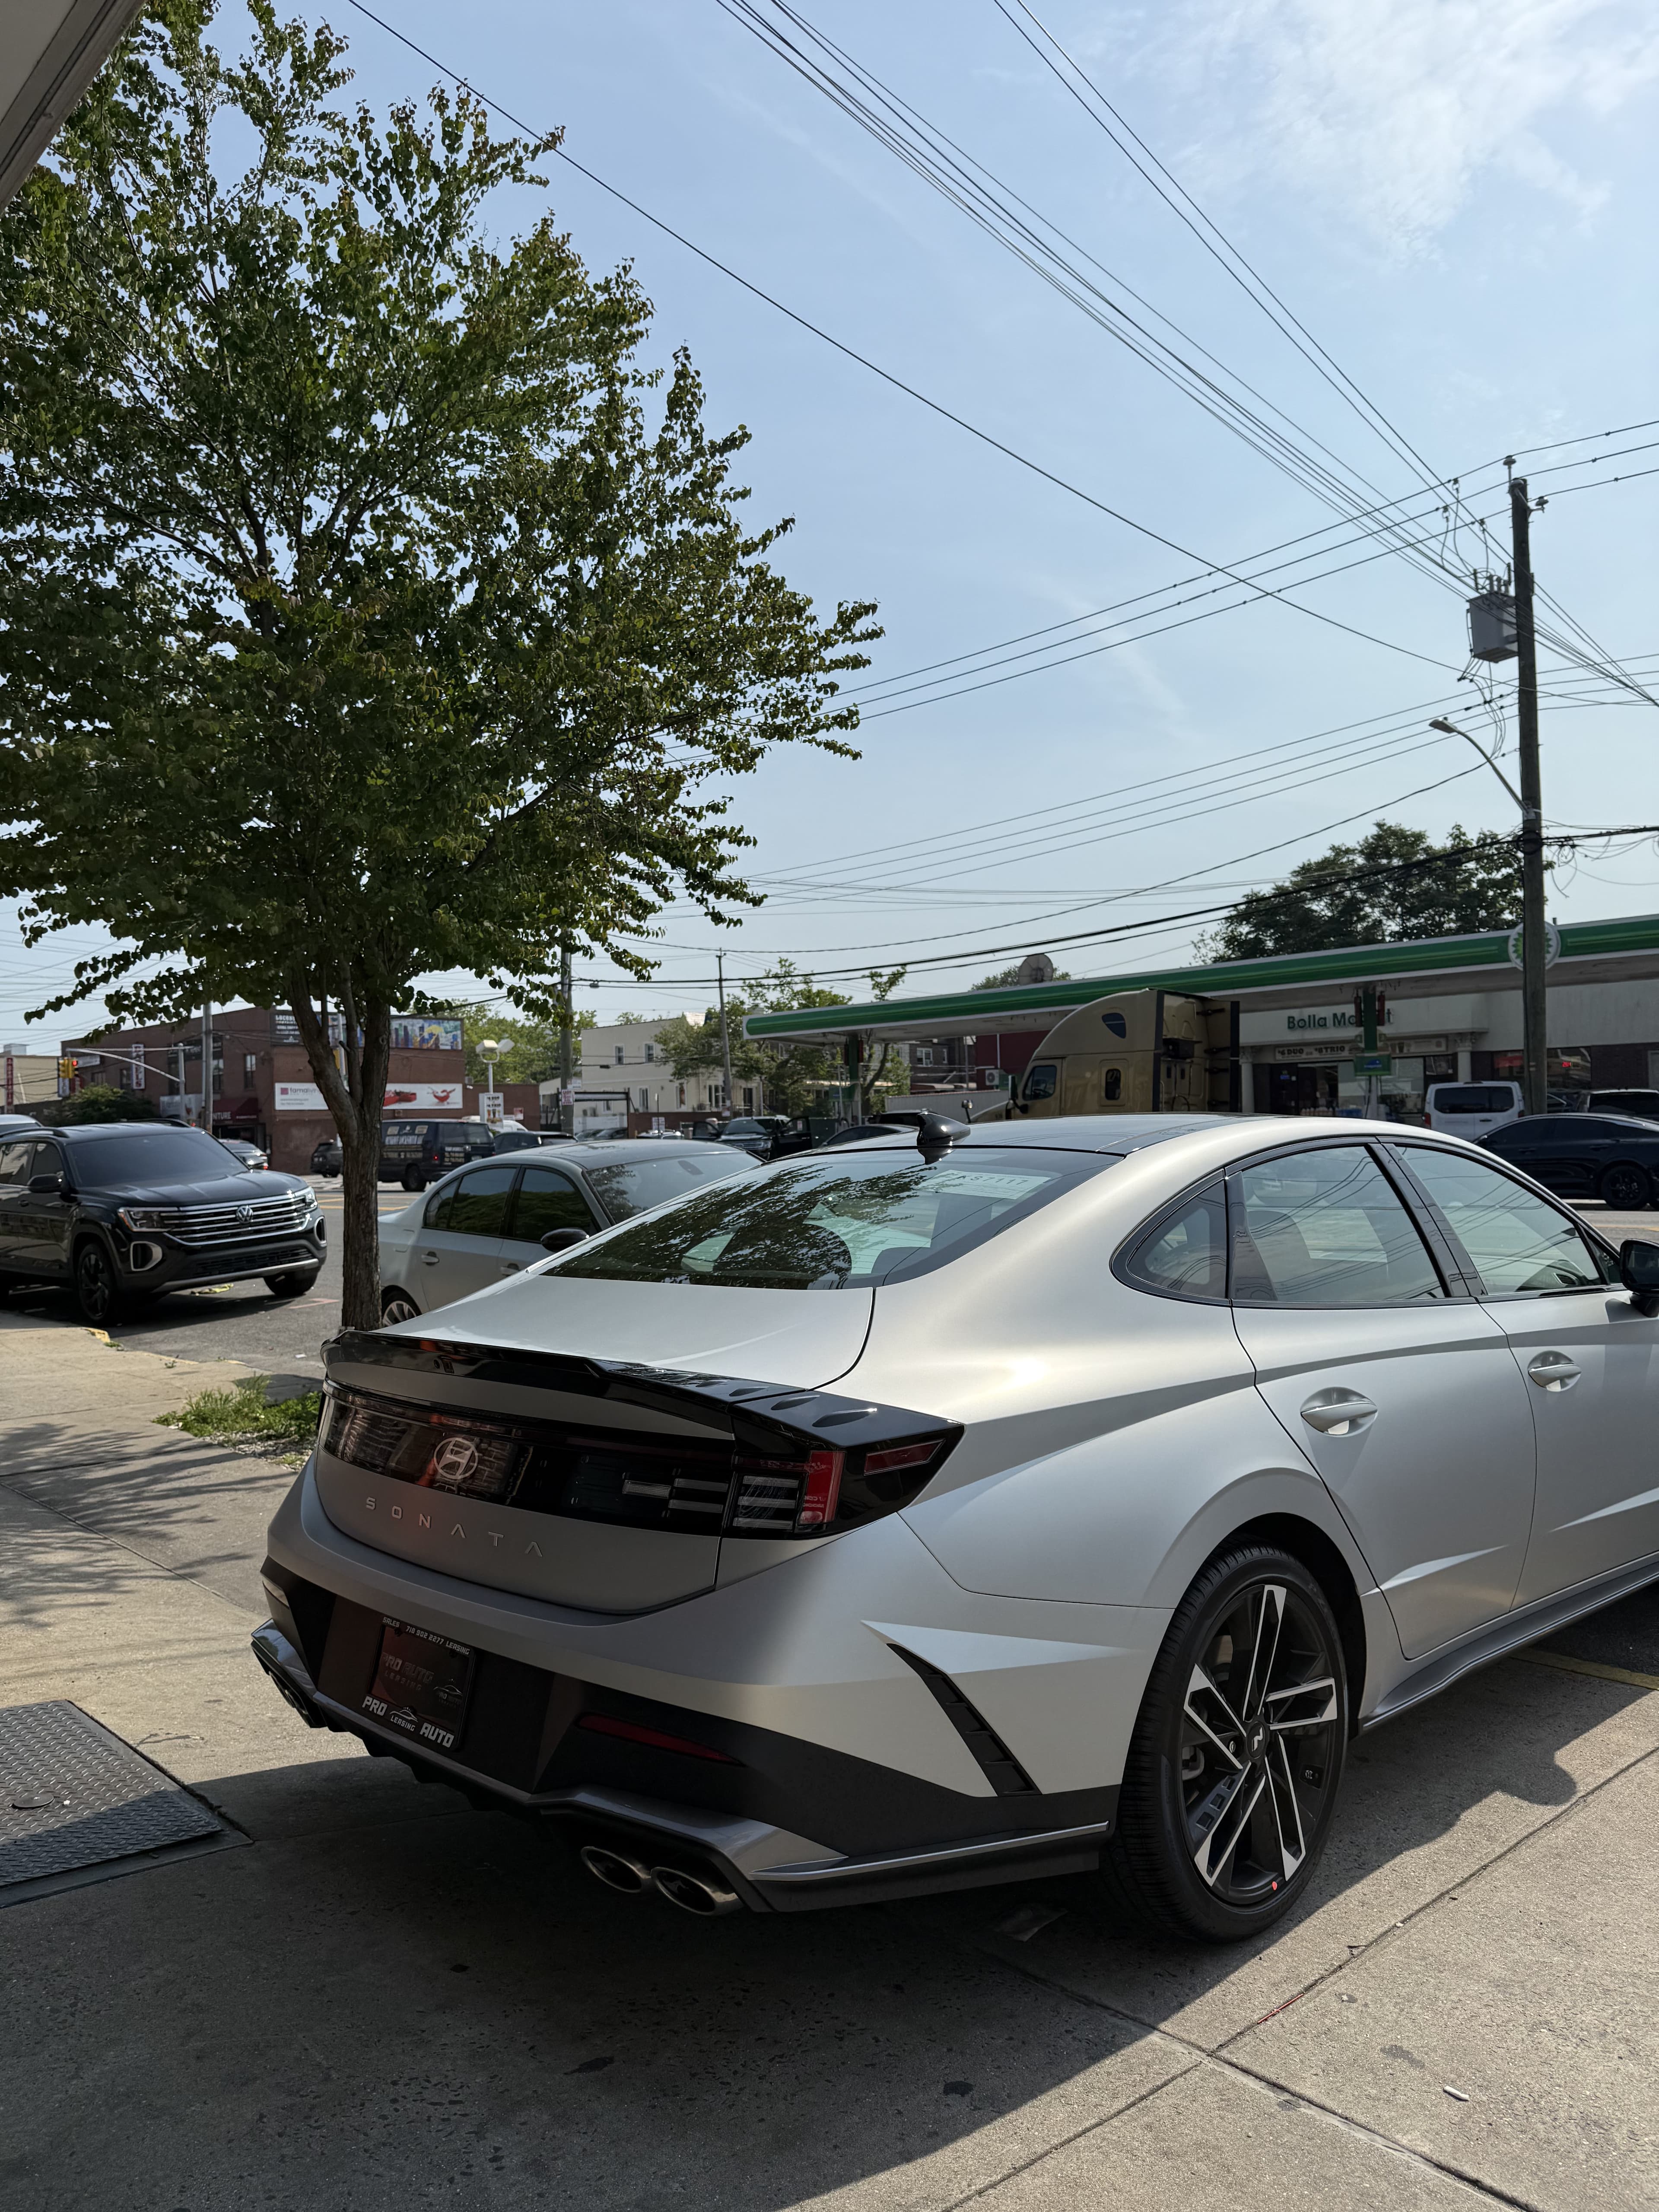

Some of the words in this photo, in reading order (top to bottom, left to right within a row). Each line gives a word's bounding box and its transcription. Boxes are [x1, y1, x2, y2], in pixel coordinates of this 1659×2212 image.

[1287, 1014, 1327, 1029] Bolla
[1333, 1008, 1392, 1027] Mat
[213, 1112, 231, 1120] NITURE
[366, 1497, 543, 1557] SONATA
[382, 1617, 400, 1628] SALES
[406, 1626, 416, 1634] 718
[416, 1630, 428, 1639] 902
[429, 1634, 445, 1645] 2277
[446, 1640, 470, 1655] LEASING
[384, 1670, 422, 1691] LEASING
[401, 1662, 435, 1684] AUTO
[362, 1696, 388, 1716] PRO
[391, 1715, 416, 1732] LEASING
[420, 1722, 454, 1748] AUTO
